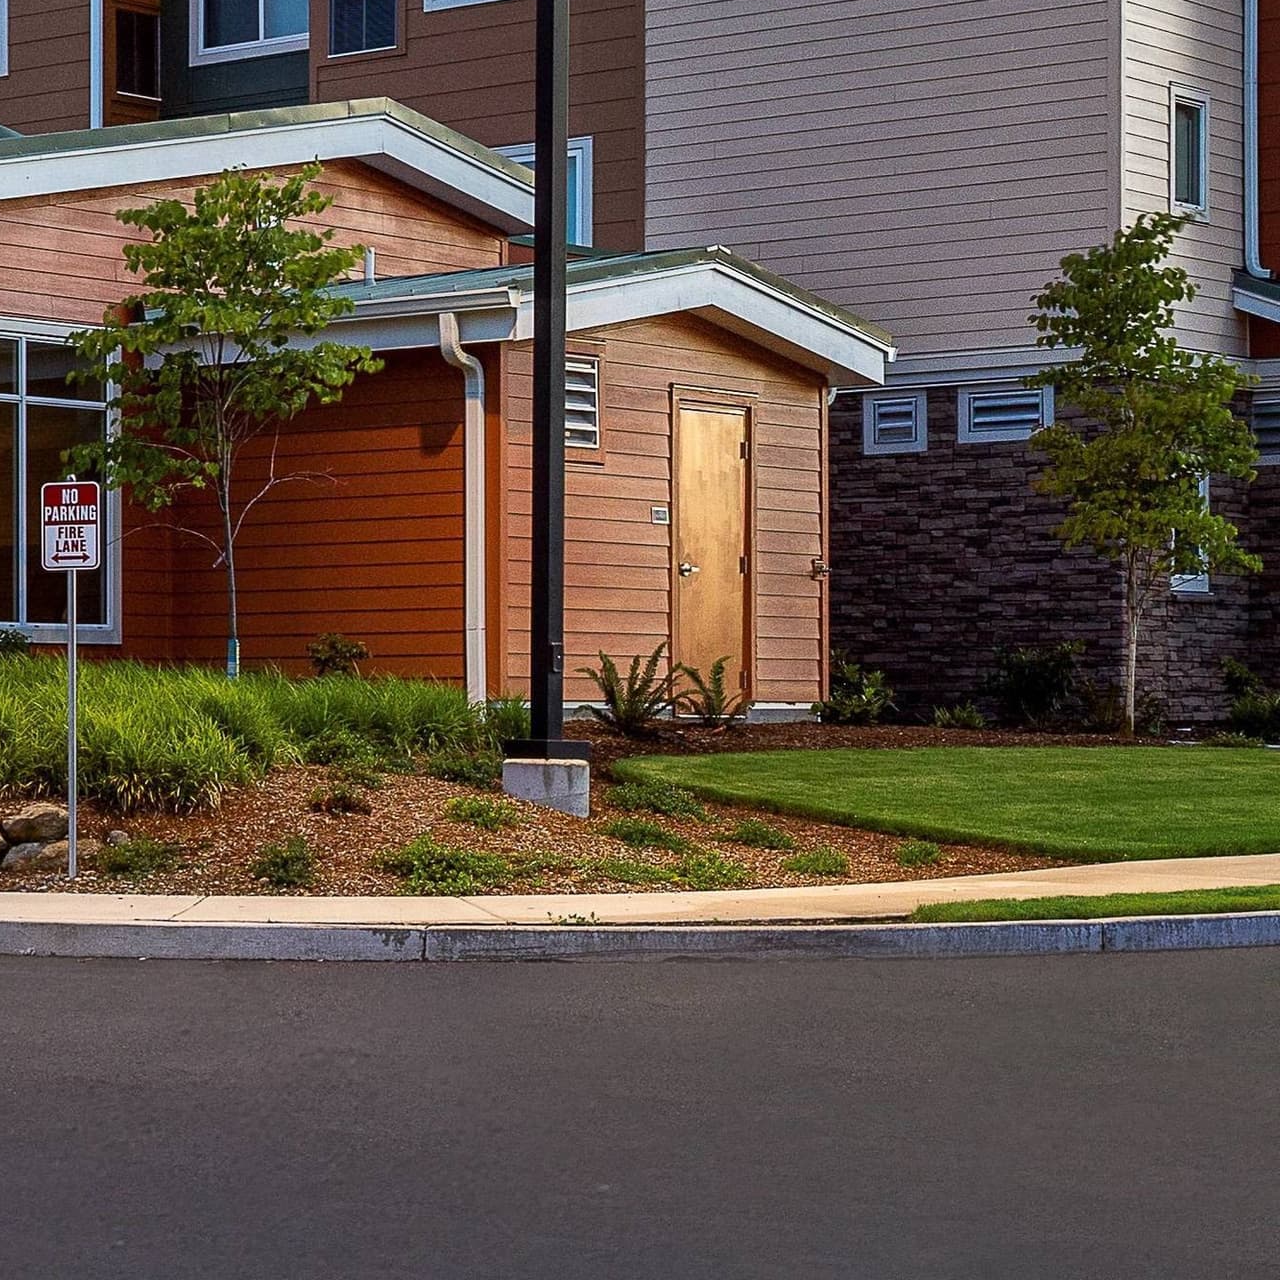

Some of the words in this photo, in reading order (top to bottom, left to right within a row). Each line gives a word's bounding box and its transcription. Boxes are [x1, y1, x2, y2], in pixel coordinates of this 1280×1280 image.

[62, 489, 78, 504] NO
[45, 505, 96, 521] PARKING
[58, 526, 84, 539] FIRE
[56, 540, 87, 552] LANE
